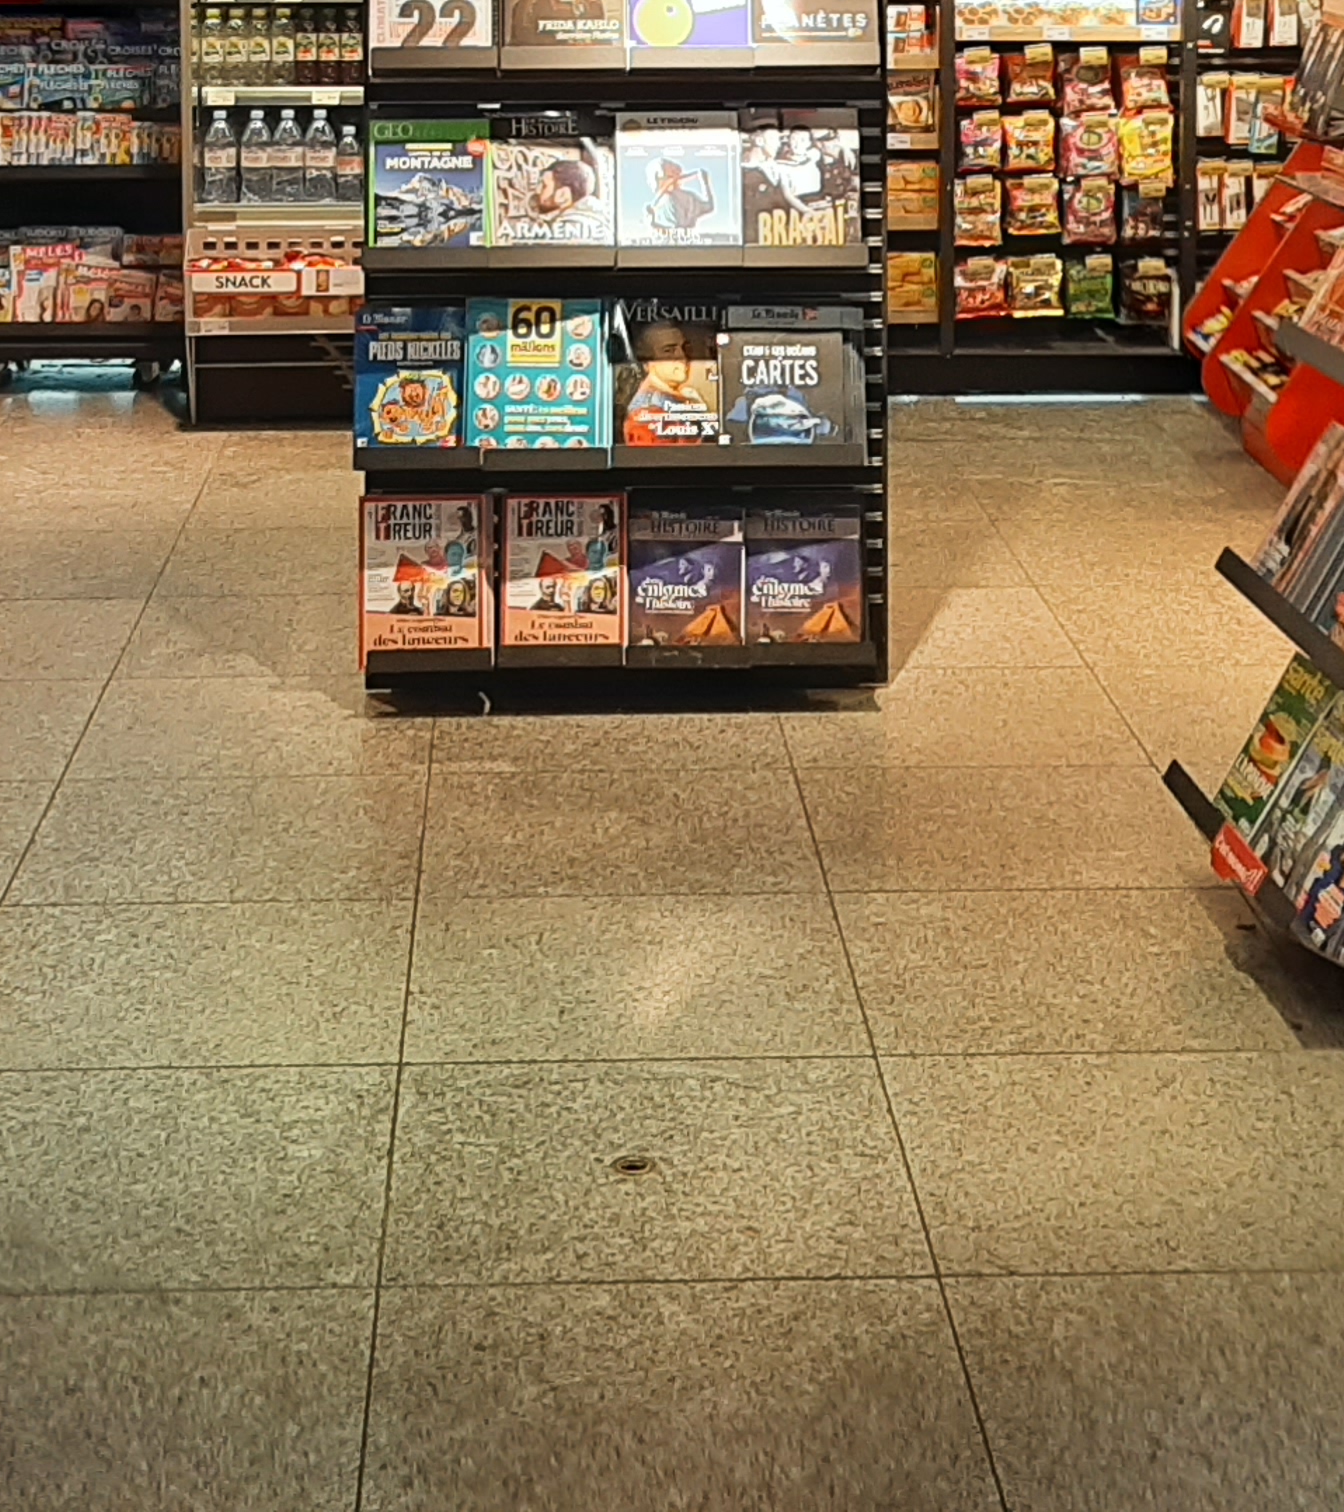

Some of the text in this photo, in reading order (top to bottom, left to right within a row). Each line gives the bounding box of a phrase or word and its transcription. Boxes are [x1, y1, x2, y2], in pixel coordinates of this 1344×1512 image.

[373, 122, 413, 139] GEO
[385, 155, 474, 170] MONTAGNE
[214, 275, 272, 289] SNACK
[510, 304, 556, 339] 60
[368, 340, 404, 361] PIEDS
[742, 358, 819, 386] CARTES
[375, 502, 433, 522] FRANC
[517, 499, 576, 519] FRANC
[375, 521, 433, 541] TIREUR
[518, 518, 576, 538] TIREUR
